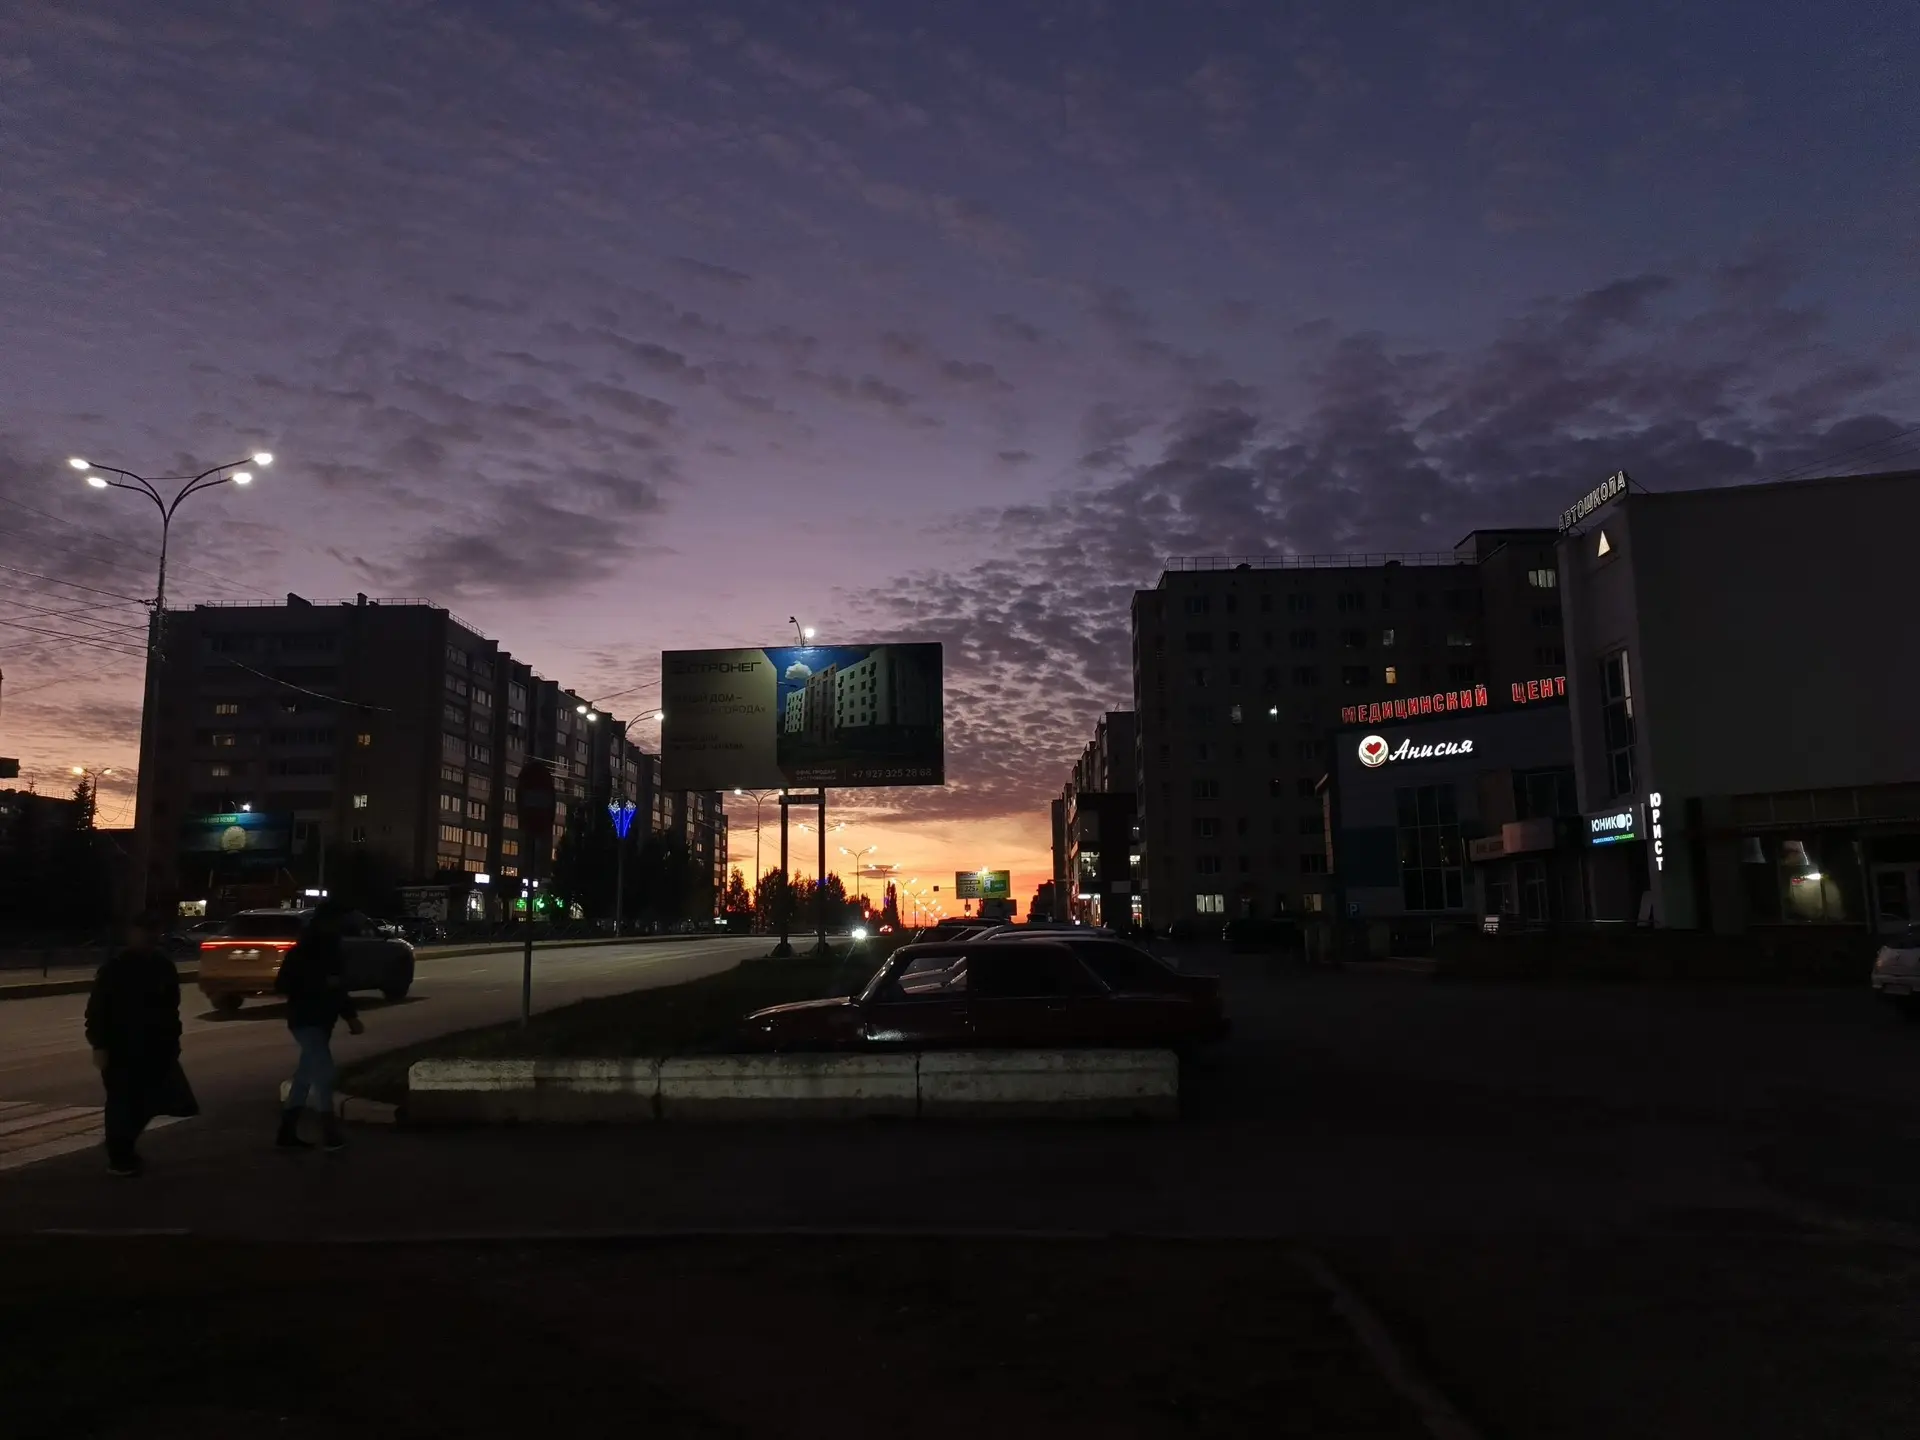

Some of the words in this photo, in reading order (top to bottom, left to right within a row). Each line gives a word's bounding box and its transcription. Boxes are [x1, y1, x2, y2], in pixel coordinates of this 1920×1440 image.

[1558, 470, 1625, 532] АВТОШКОЛА
[1341, 683, 1488, 724] МЕДИЦИНСКИЙ
[1389, 738, 1473, 762] Анисия
[851, 770, 864, 779] +7
[1649, 792, 1664, 871] ЮРИСТ
